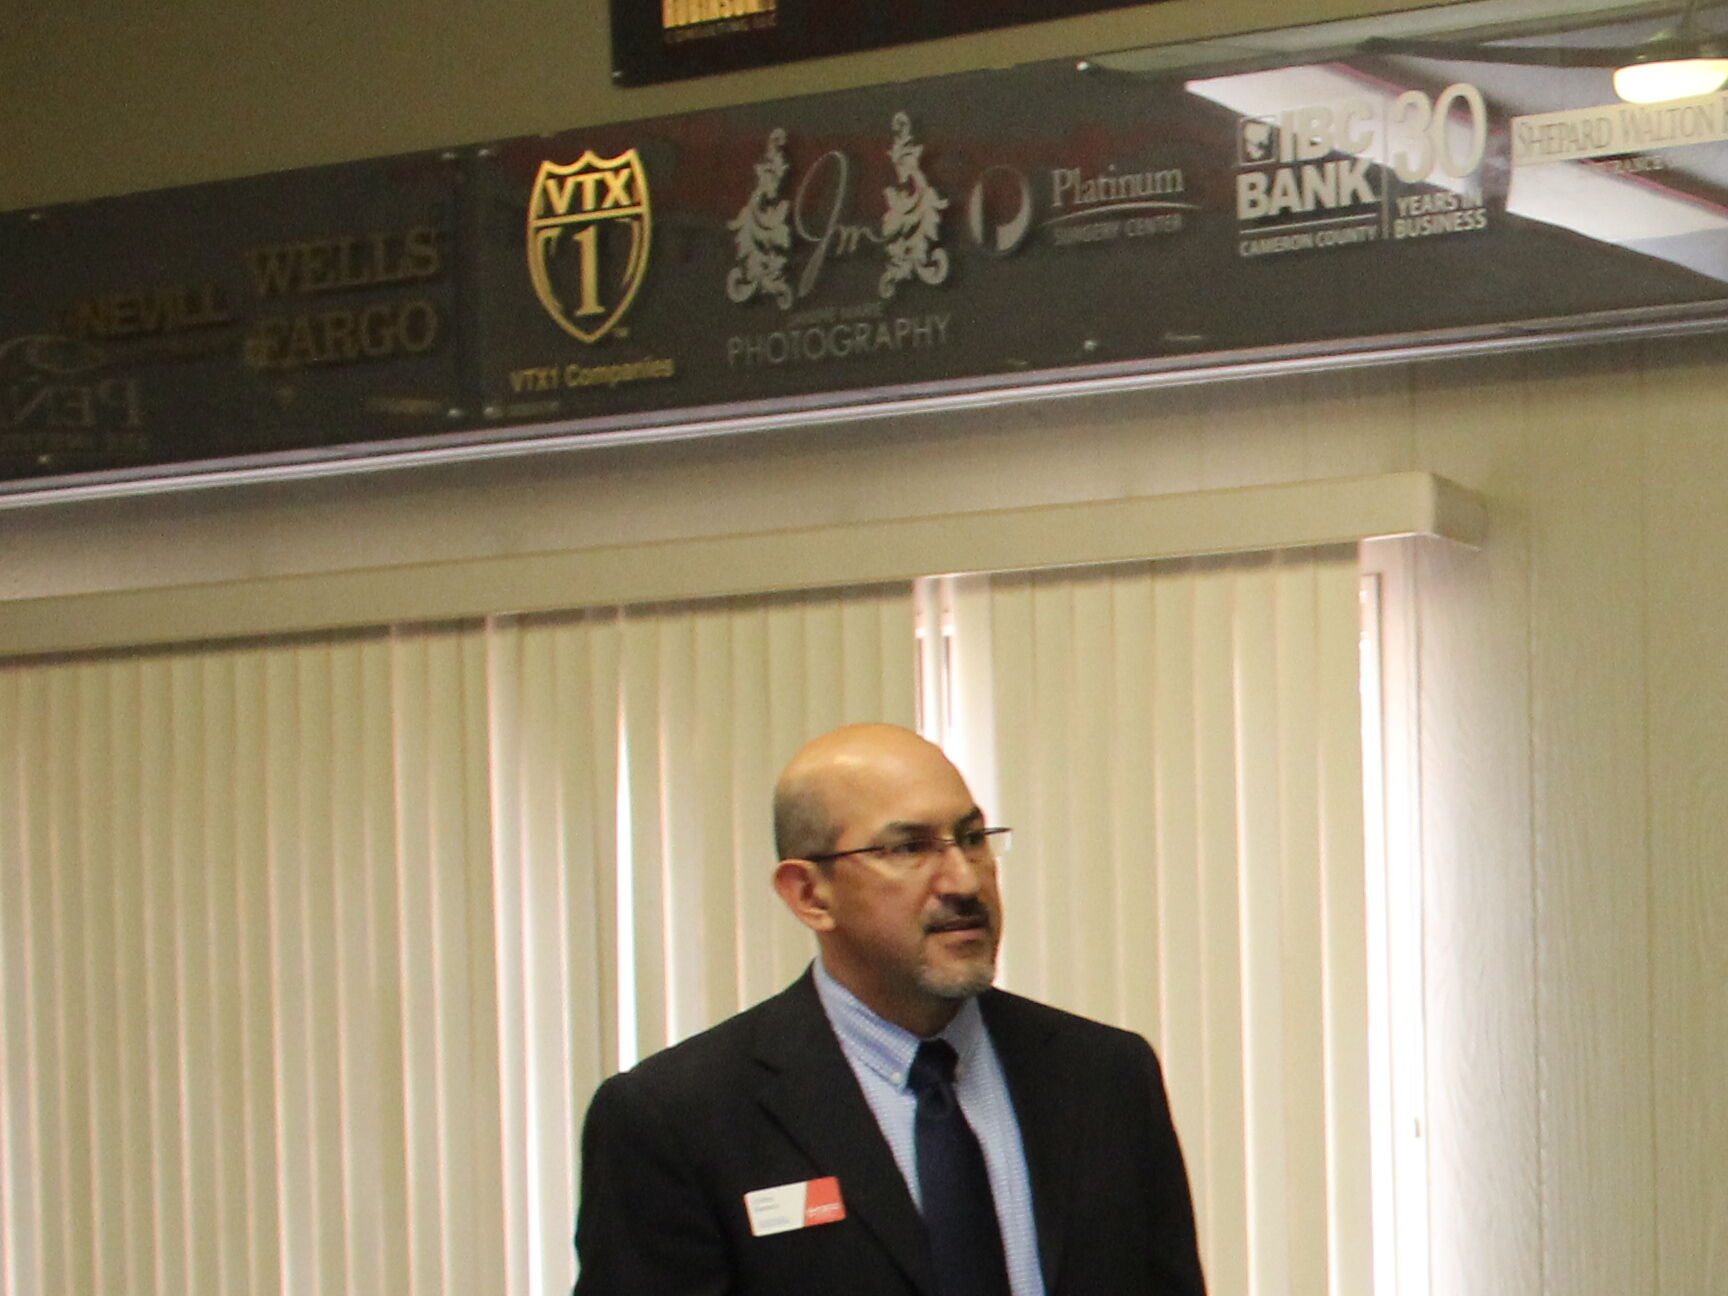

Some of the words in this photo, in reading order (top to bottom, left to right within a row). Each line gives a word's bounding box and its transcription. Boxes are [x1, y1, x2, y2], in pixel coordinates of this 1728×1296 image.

[1280, 103, 1376, 162] IBC
[1393, 83, 1487, 183] 30
[1518, 117, 1613, 154] SHEPARD
[1620, 104, 1715, 143] WALTON
[544, 168, 633, 215] VTX
[1053, 164, 1184, 207] Platinum
[1237, 158, 1383, 220] BANK
[1396, 192, 1457, 217] YEARS
[1393, 208, 1487, 239] BUSINESS
[247, 225, 440, 297] WELLS
[574, 225, 606, 317] 1
[250, 301, 438, 369] FARGO
[728, 314, 951, 367] PHOTOGRAPHY
[510, 366, 563, 392] VTX1
[565, 357, 674, 388] Companies
